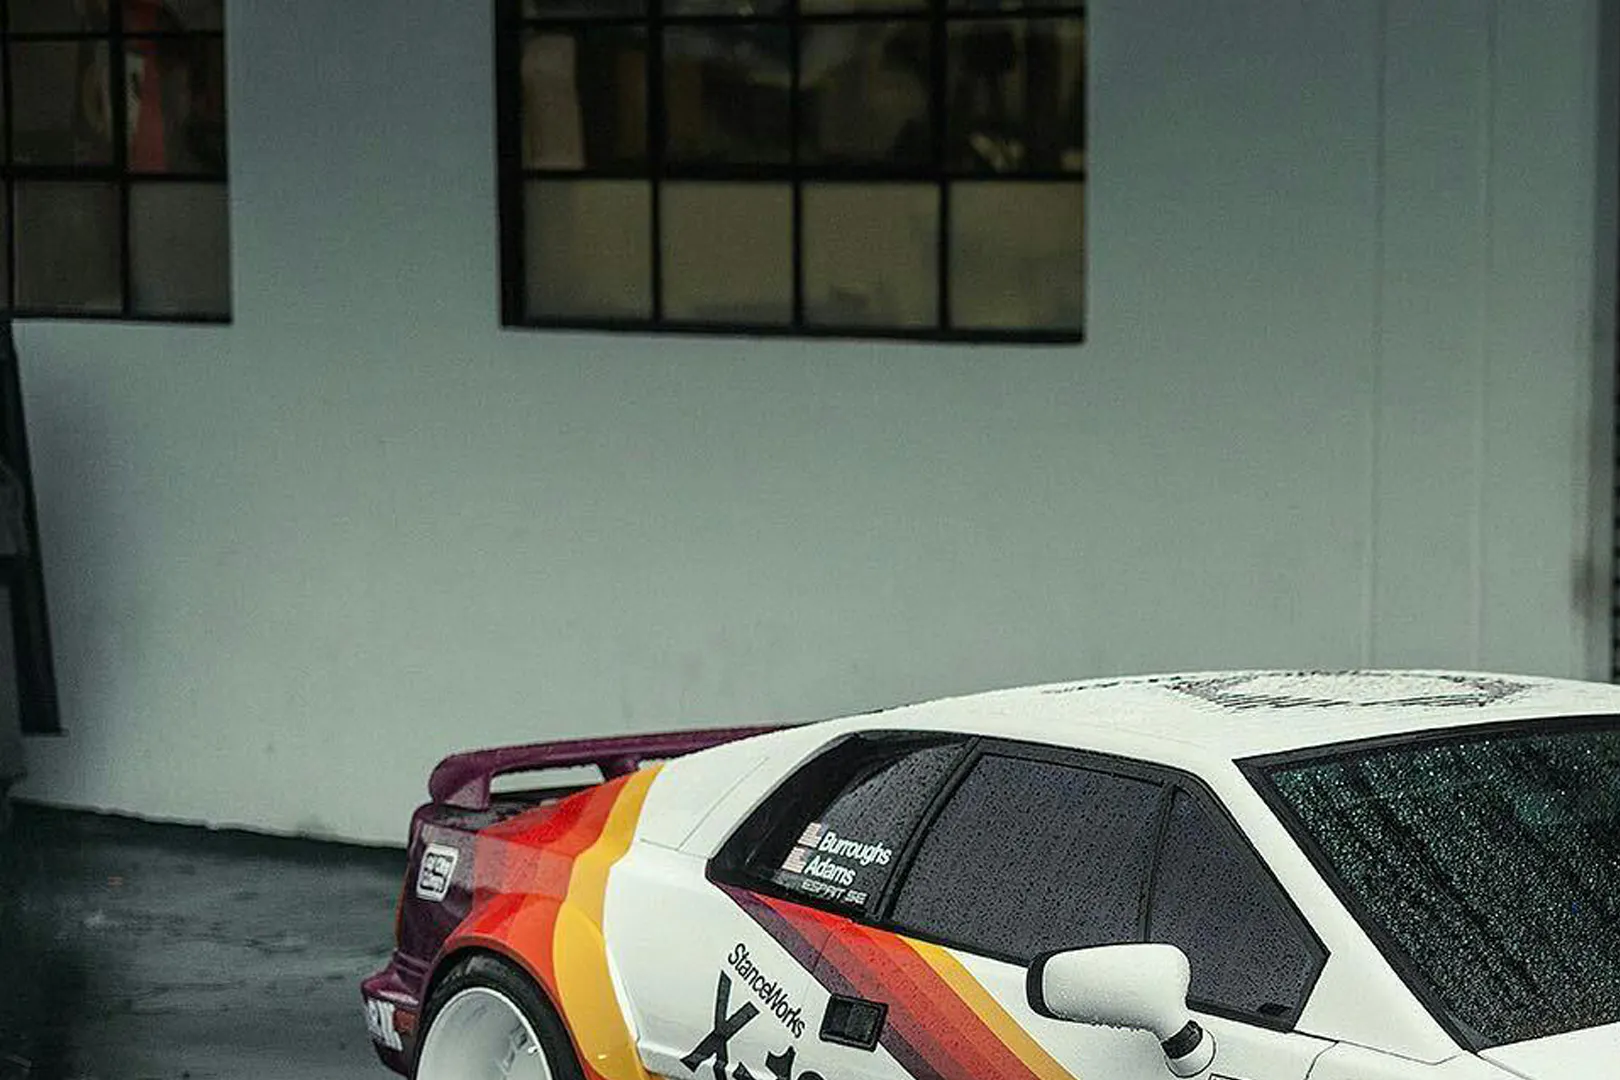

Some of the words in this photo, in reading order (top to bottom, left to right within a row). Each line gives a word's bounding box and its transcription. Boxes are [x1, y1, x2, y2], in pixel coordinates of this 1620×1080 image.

[819, 831, 892, 866] Burroughs
[803, 854, 856, 886] Adams
[728, 942, 806, 1039] StanceWorks
